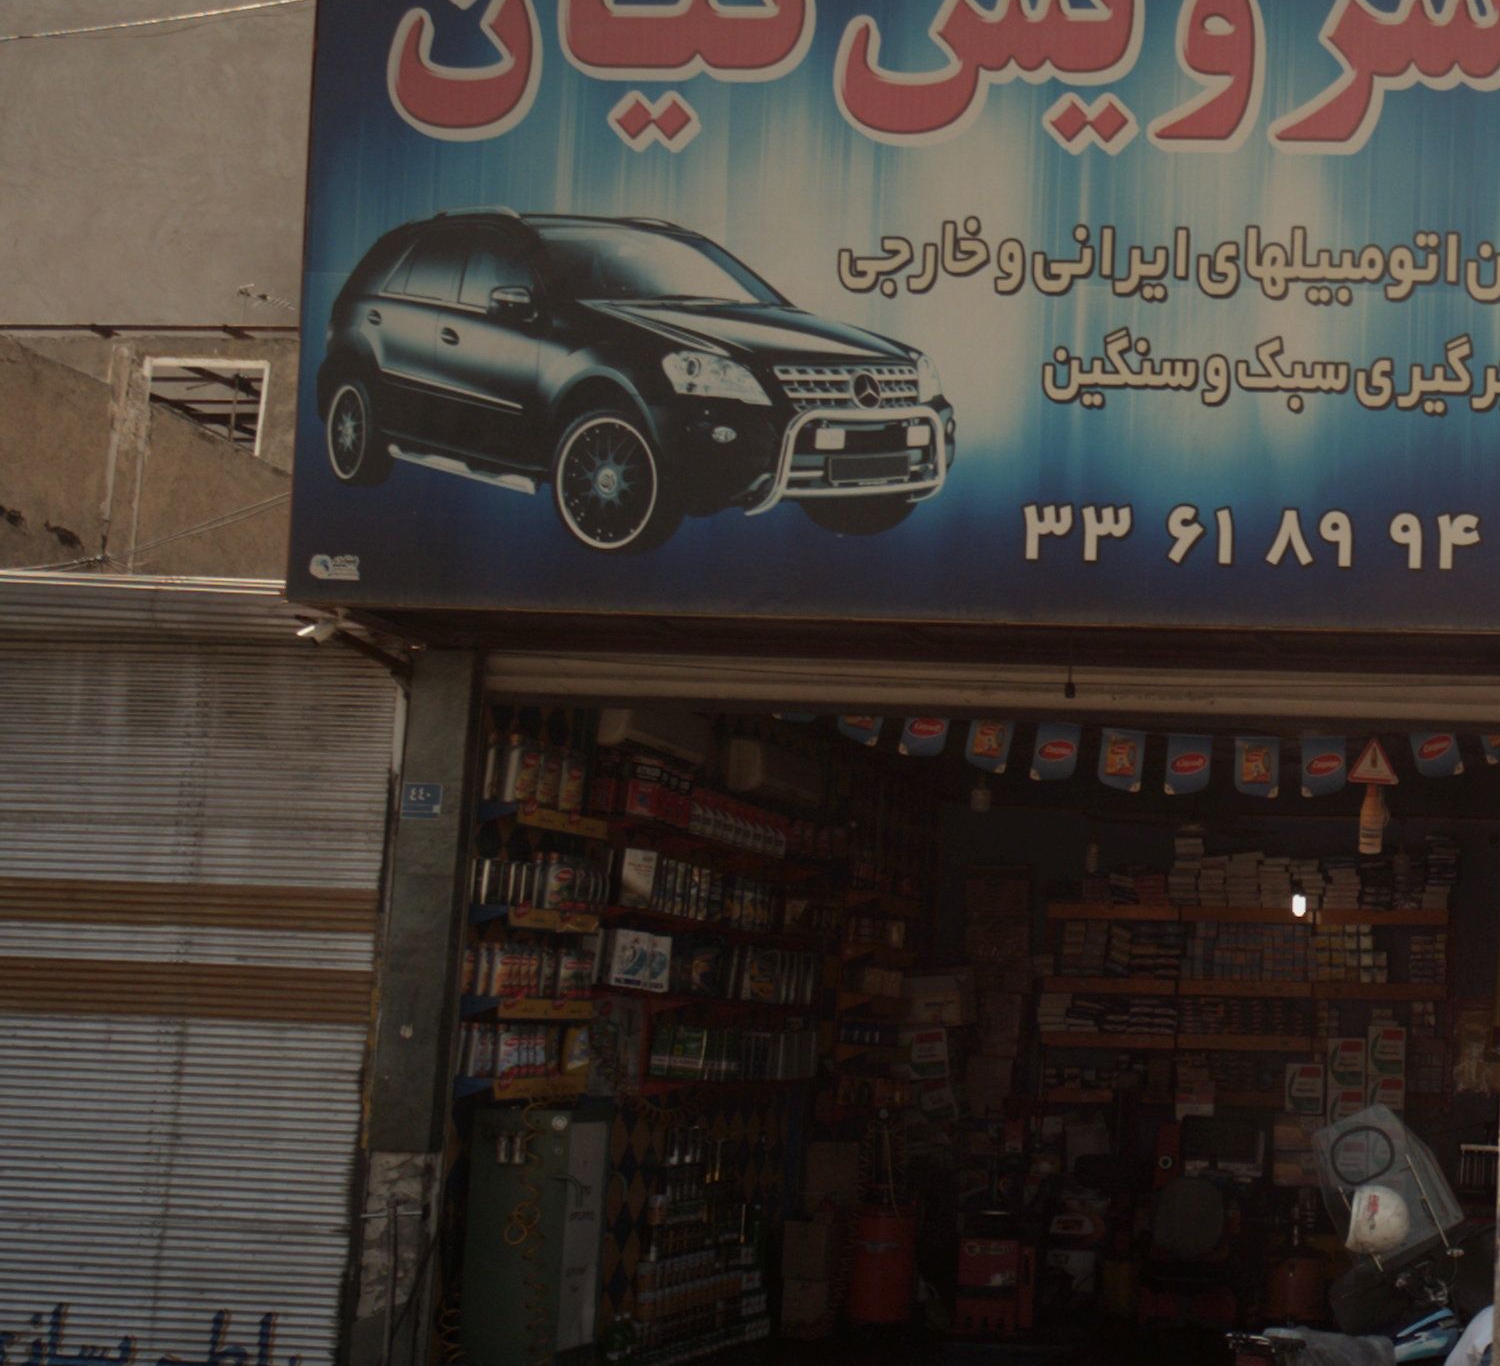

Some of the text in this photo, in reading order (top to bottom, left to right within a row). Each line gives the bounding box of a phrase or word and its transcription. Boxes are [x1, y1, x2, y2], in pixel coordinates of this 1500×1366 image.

[837, 215, 991, 298] خارجی
[994, 236, 1026, 296] و
[1032, 223, 1189, 302] ایرانی
[1041, 326, 1199, 410] سنگین
[1200, 352, 1231, 408] و
[1235, 335, 1350, 414] سبک
